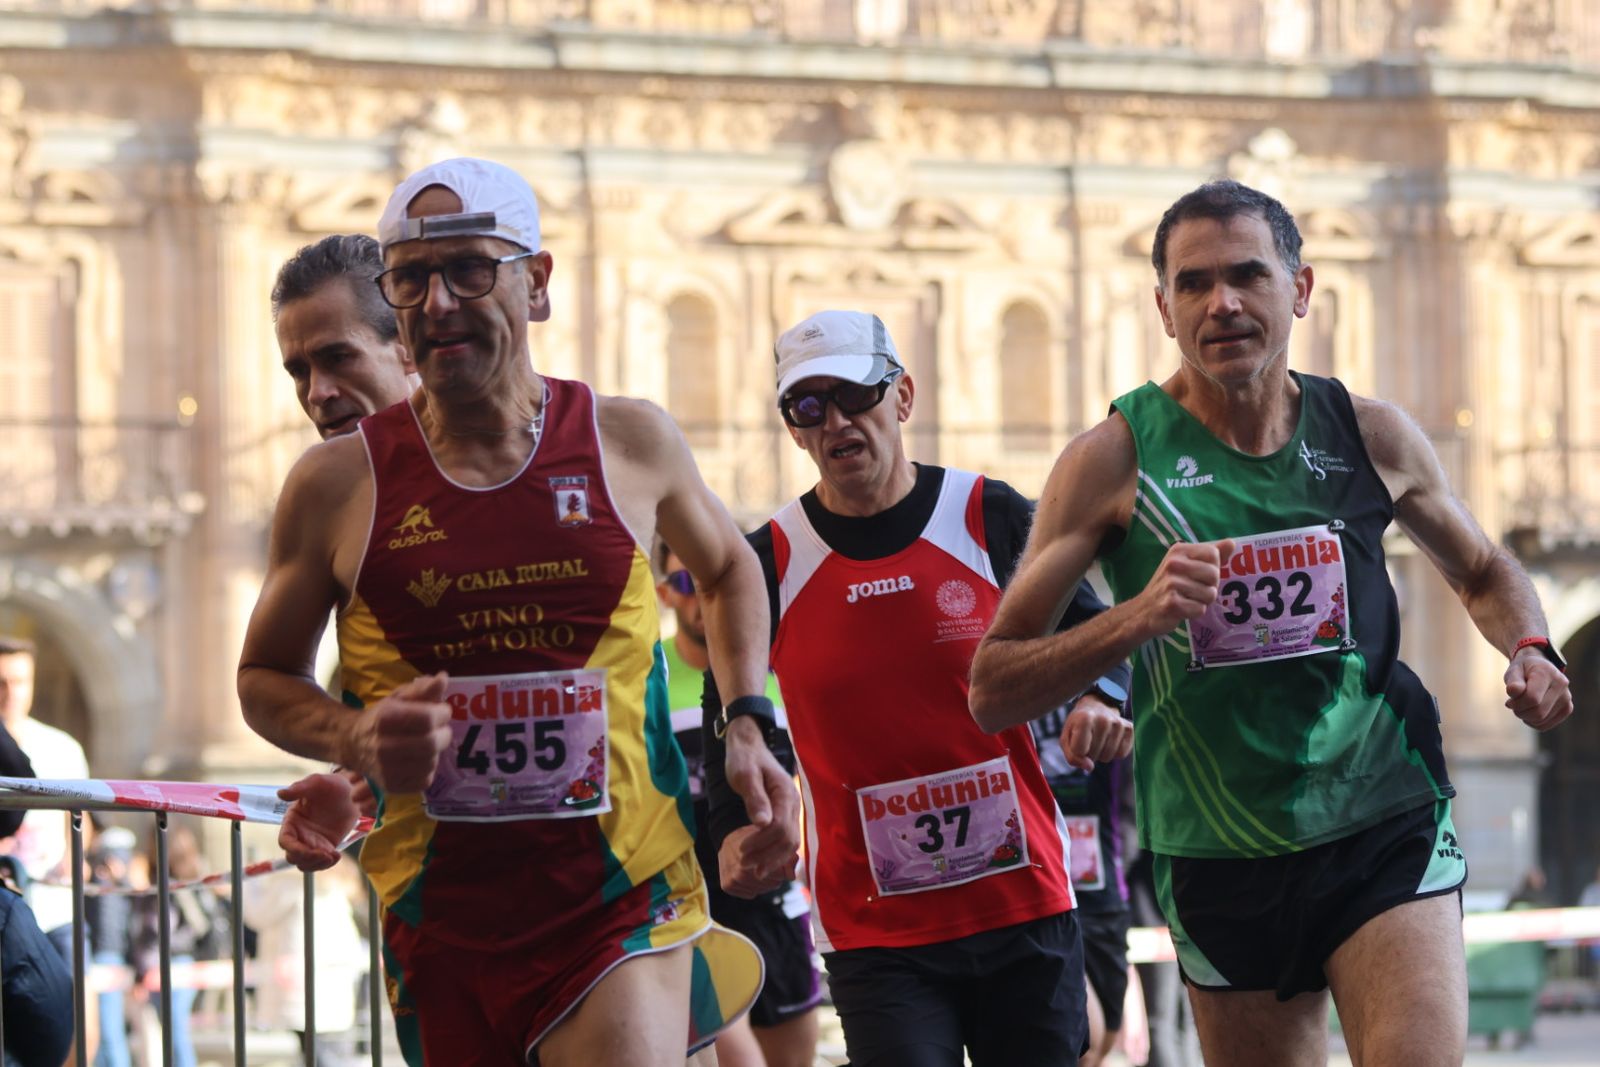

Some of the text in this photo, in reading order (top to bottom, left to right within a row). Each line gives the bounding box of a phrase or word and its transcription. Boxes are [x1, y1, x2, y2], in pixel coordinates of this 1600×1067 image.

[1165, 474, 1214, 489] VIATOR
[456, 559, 589, 592] CAJA RURAL
[458, 603, 544, 631] VINO
[1221, 571, 1316, 625] 332
[482, 624, 575, 653] TORO
[446, 679, 602, 721] edunia
[457, 719, 566, 775] 455
[862, 770, 1011, 822] bedunia
[914, 806, 971, 854] 37
